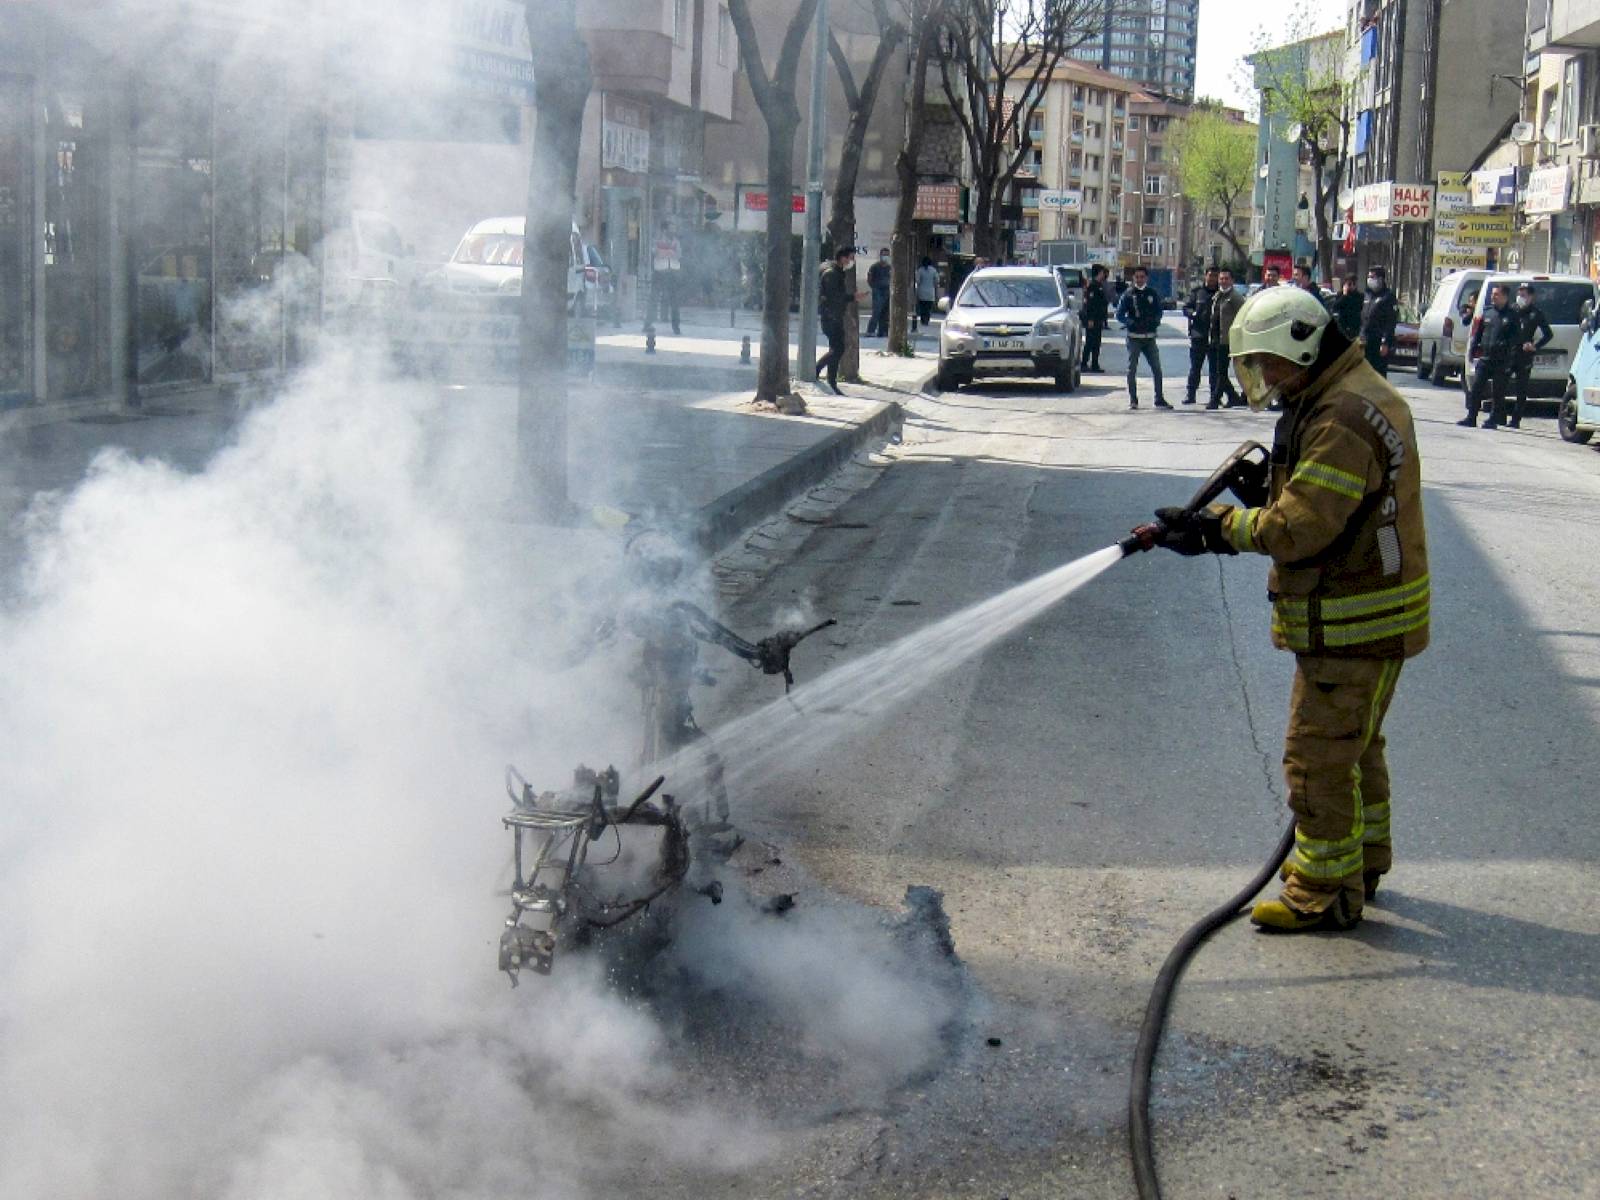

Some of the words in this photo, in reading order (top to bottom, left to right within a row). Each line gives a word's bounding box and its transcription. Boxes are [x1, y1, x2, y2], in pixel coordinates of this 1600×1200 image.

[1394, 188, 1431, 202] HALK
[1393, 204, 1429, 217] SPOT
[1440, 255, 1481, 265] Telefon
